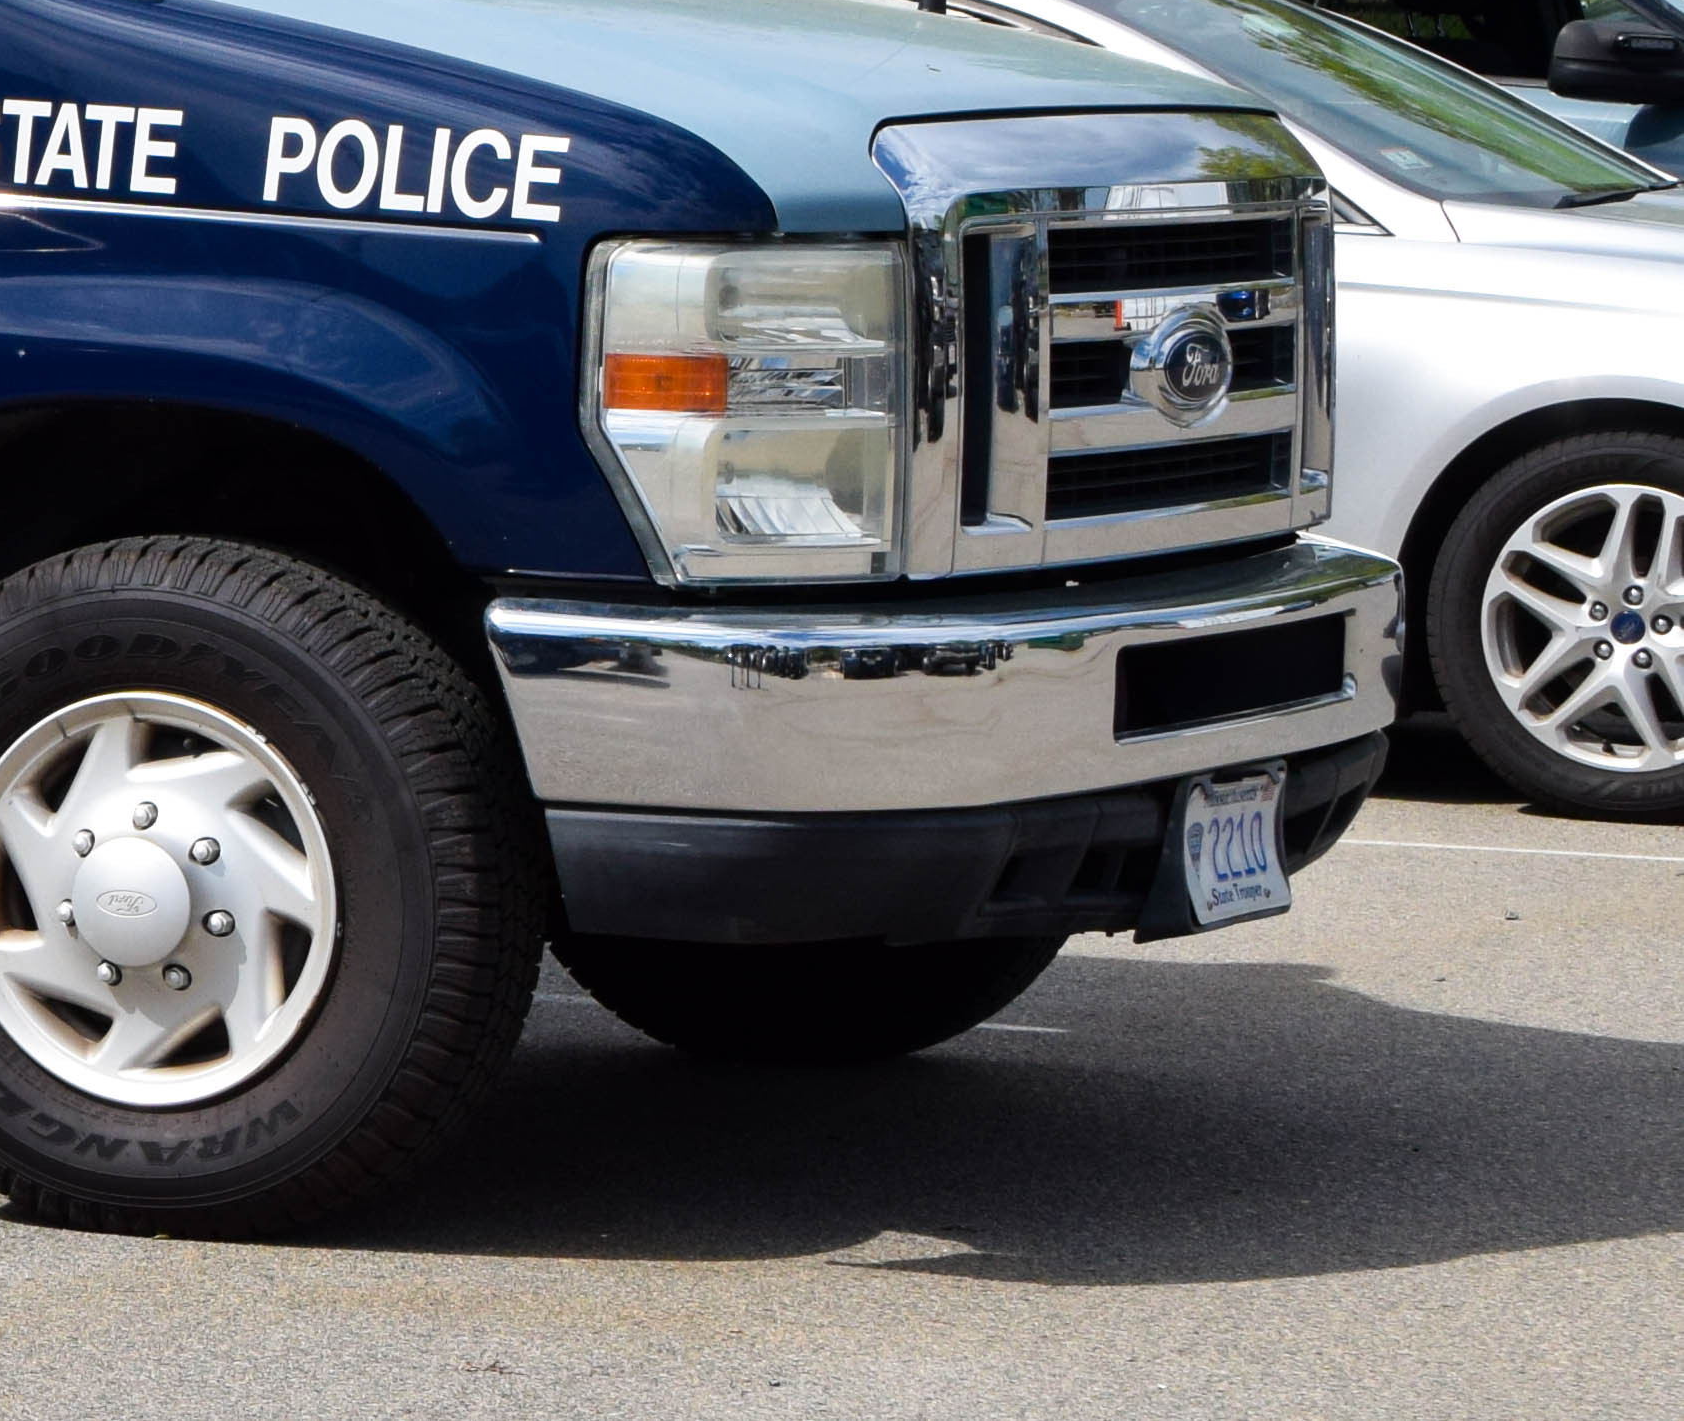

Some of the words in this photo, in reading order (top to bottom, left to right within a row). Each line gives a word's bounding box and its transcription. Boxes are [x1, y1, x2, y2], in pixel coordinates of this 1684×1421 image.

[262, 116, 570, 222] POLICE
[1182, 343, 1220, 387] Ford
[1208, 811, 1267, 882] 2210
